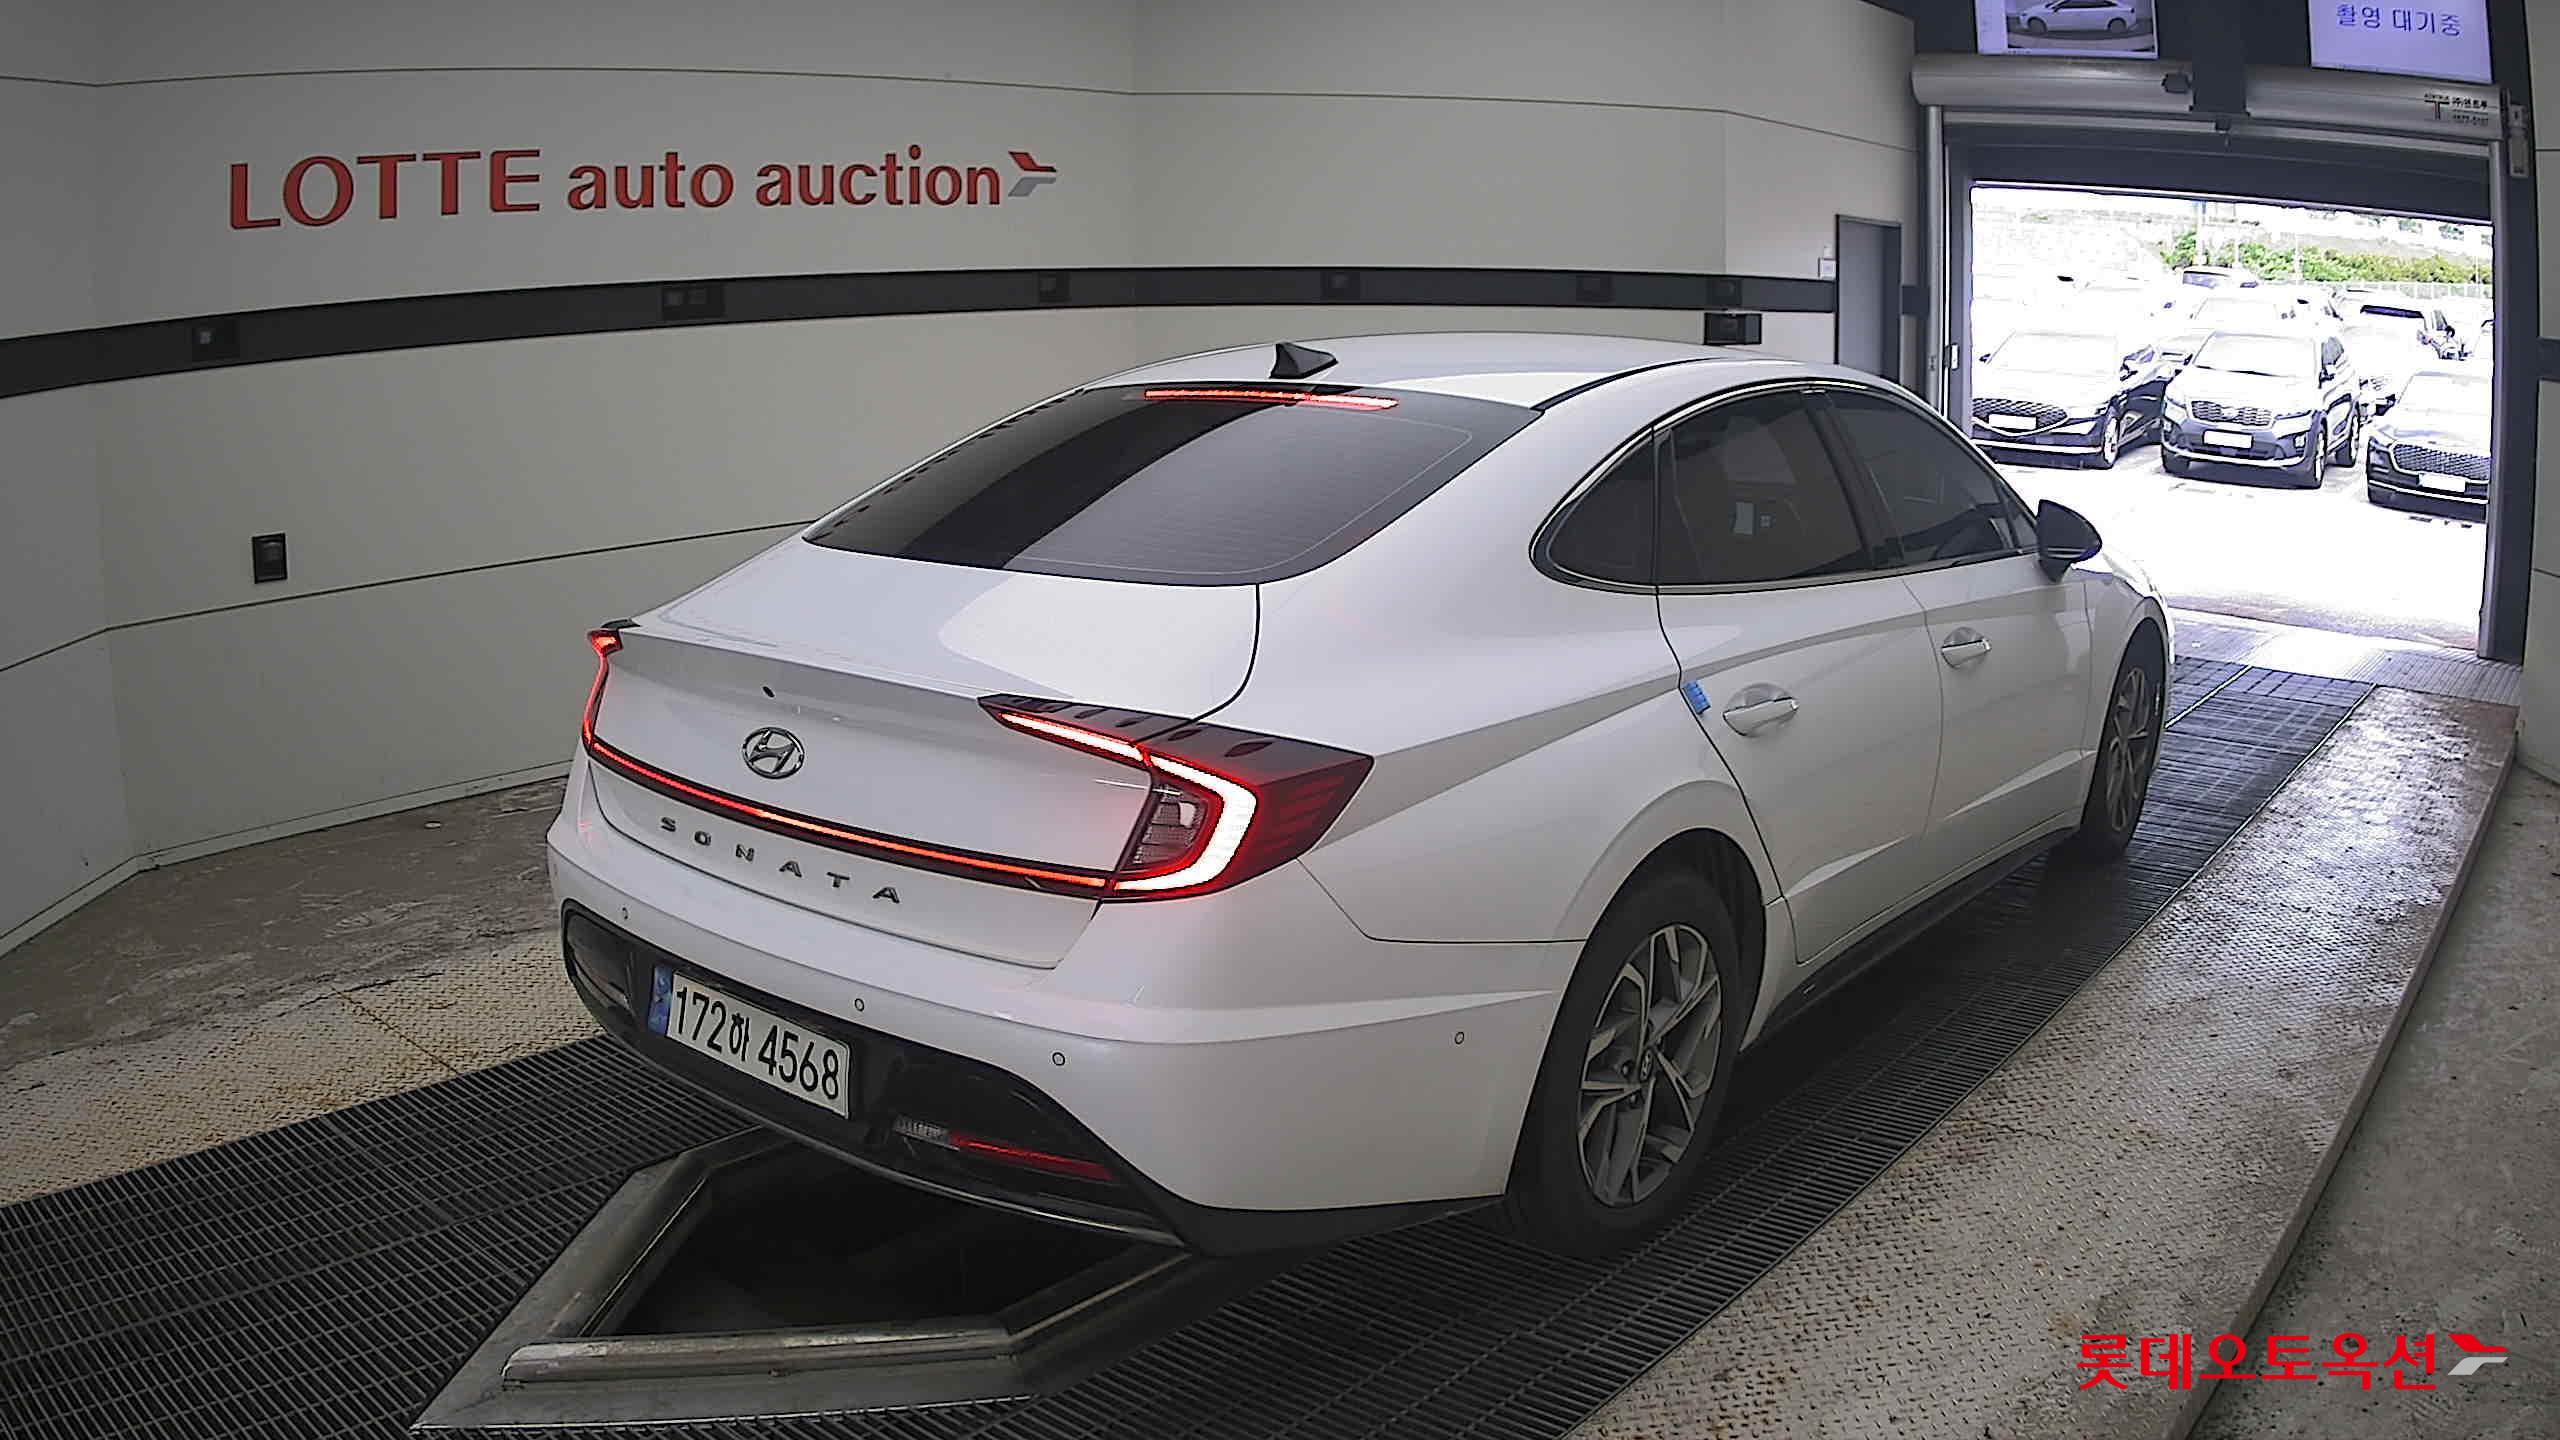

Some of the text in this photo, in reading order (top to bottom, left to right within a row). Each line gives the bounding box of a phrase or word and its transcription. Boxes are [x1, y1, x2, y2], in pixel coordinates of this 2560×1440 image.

[2336, 4, 2461, 37] 촬영 대기중
[230, 145, 1002, 229] LOTTE auto auction
[660, 816, 901, 904] SONATA
[676, 986, 750, 1062] 172하
[758, 1024, 840, 1100] 4568
